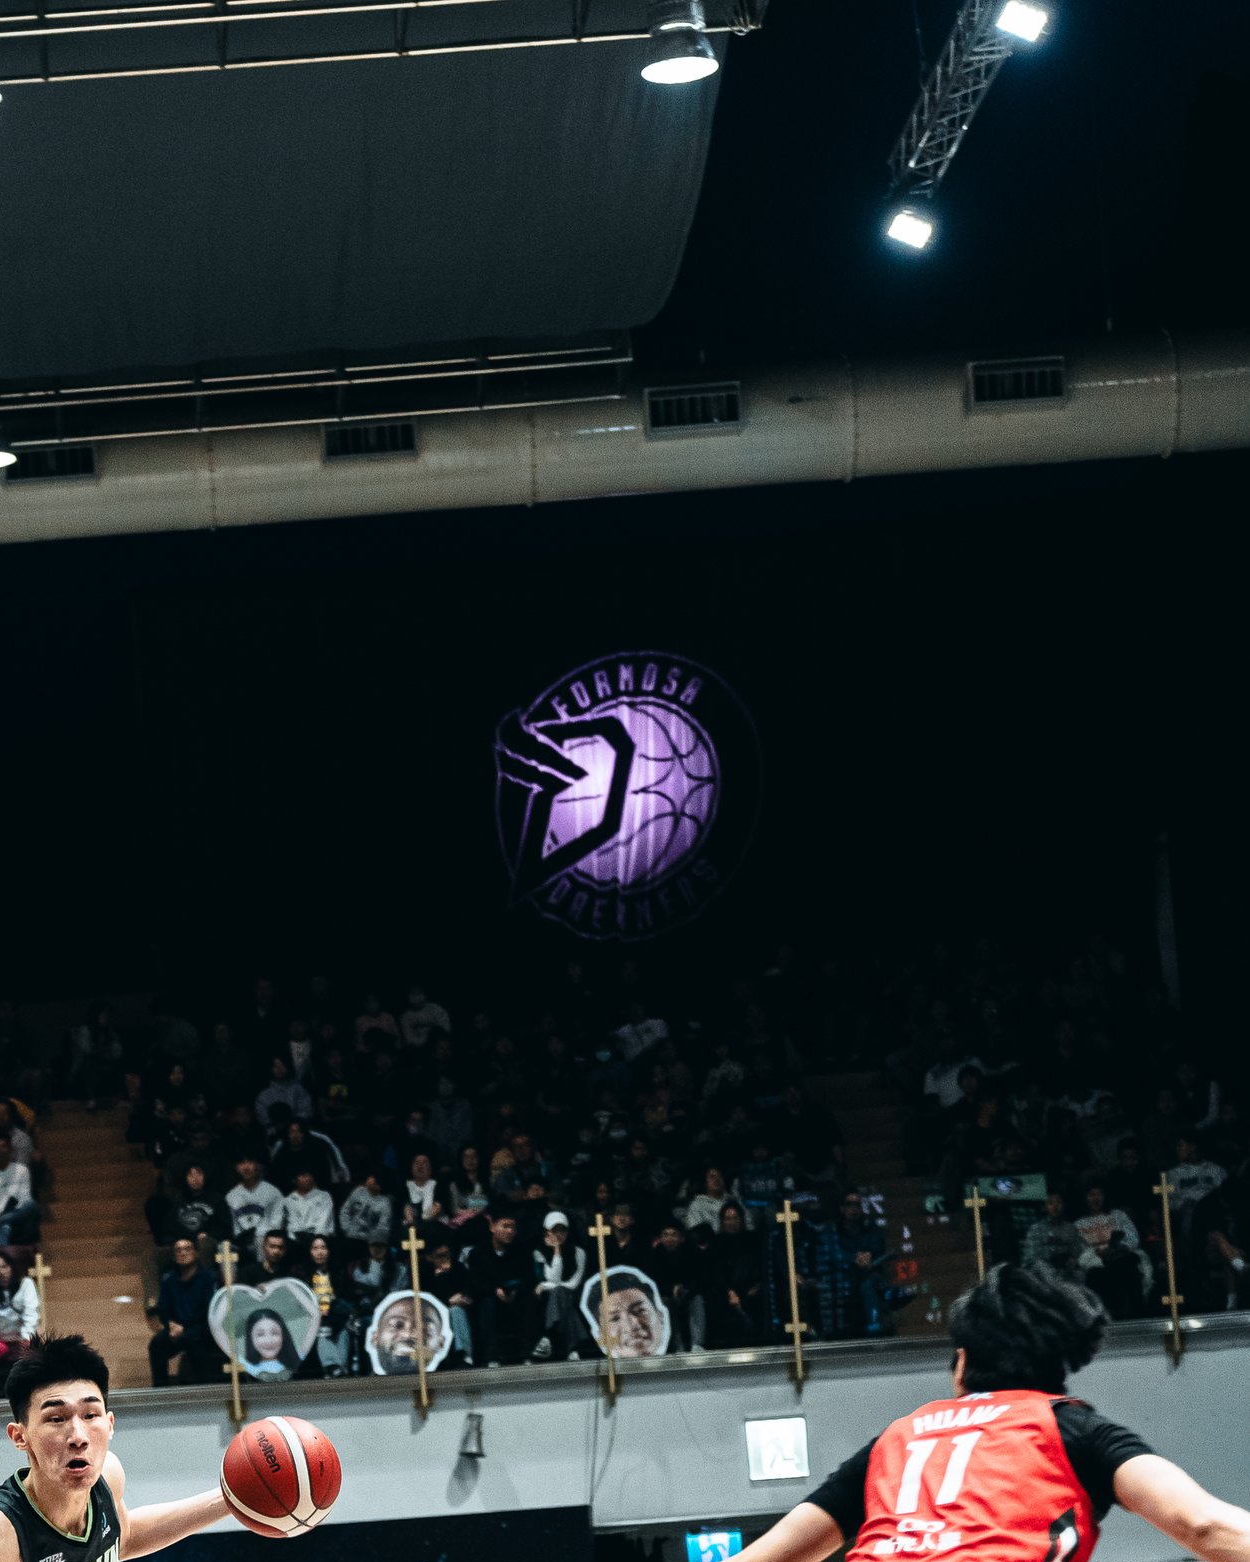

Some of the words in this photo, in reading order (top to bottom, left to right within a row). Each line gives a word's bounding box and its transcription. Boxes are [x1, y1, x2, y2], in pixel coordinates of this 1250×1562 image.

[550, 662, 705, 721] FORMOSA
[255, 1430, 281, 1473] molten
[895, 1431, 983, 1514] 11
